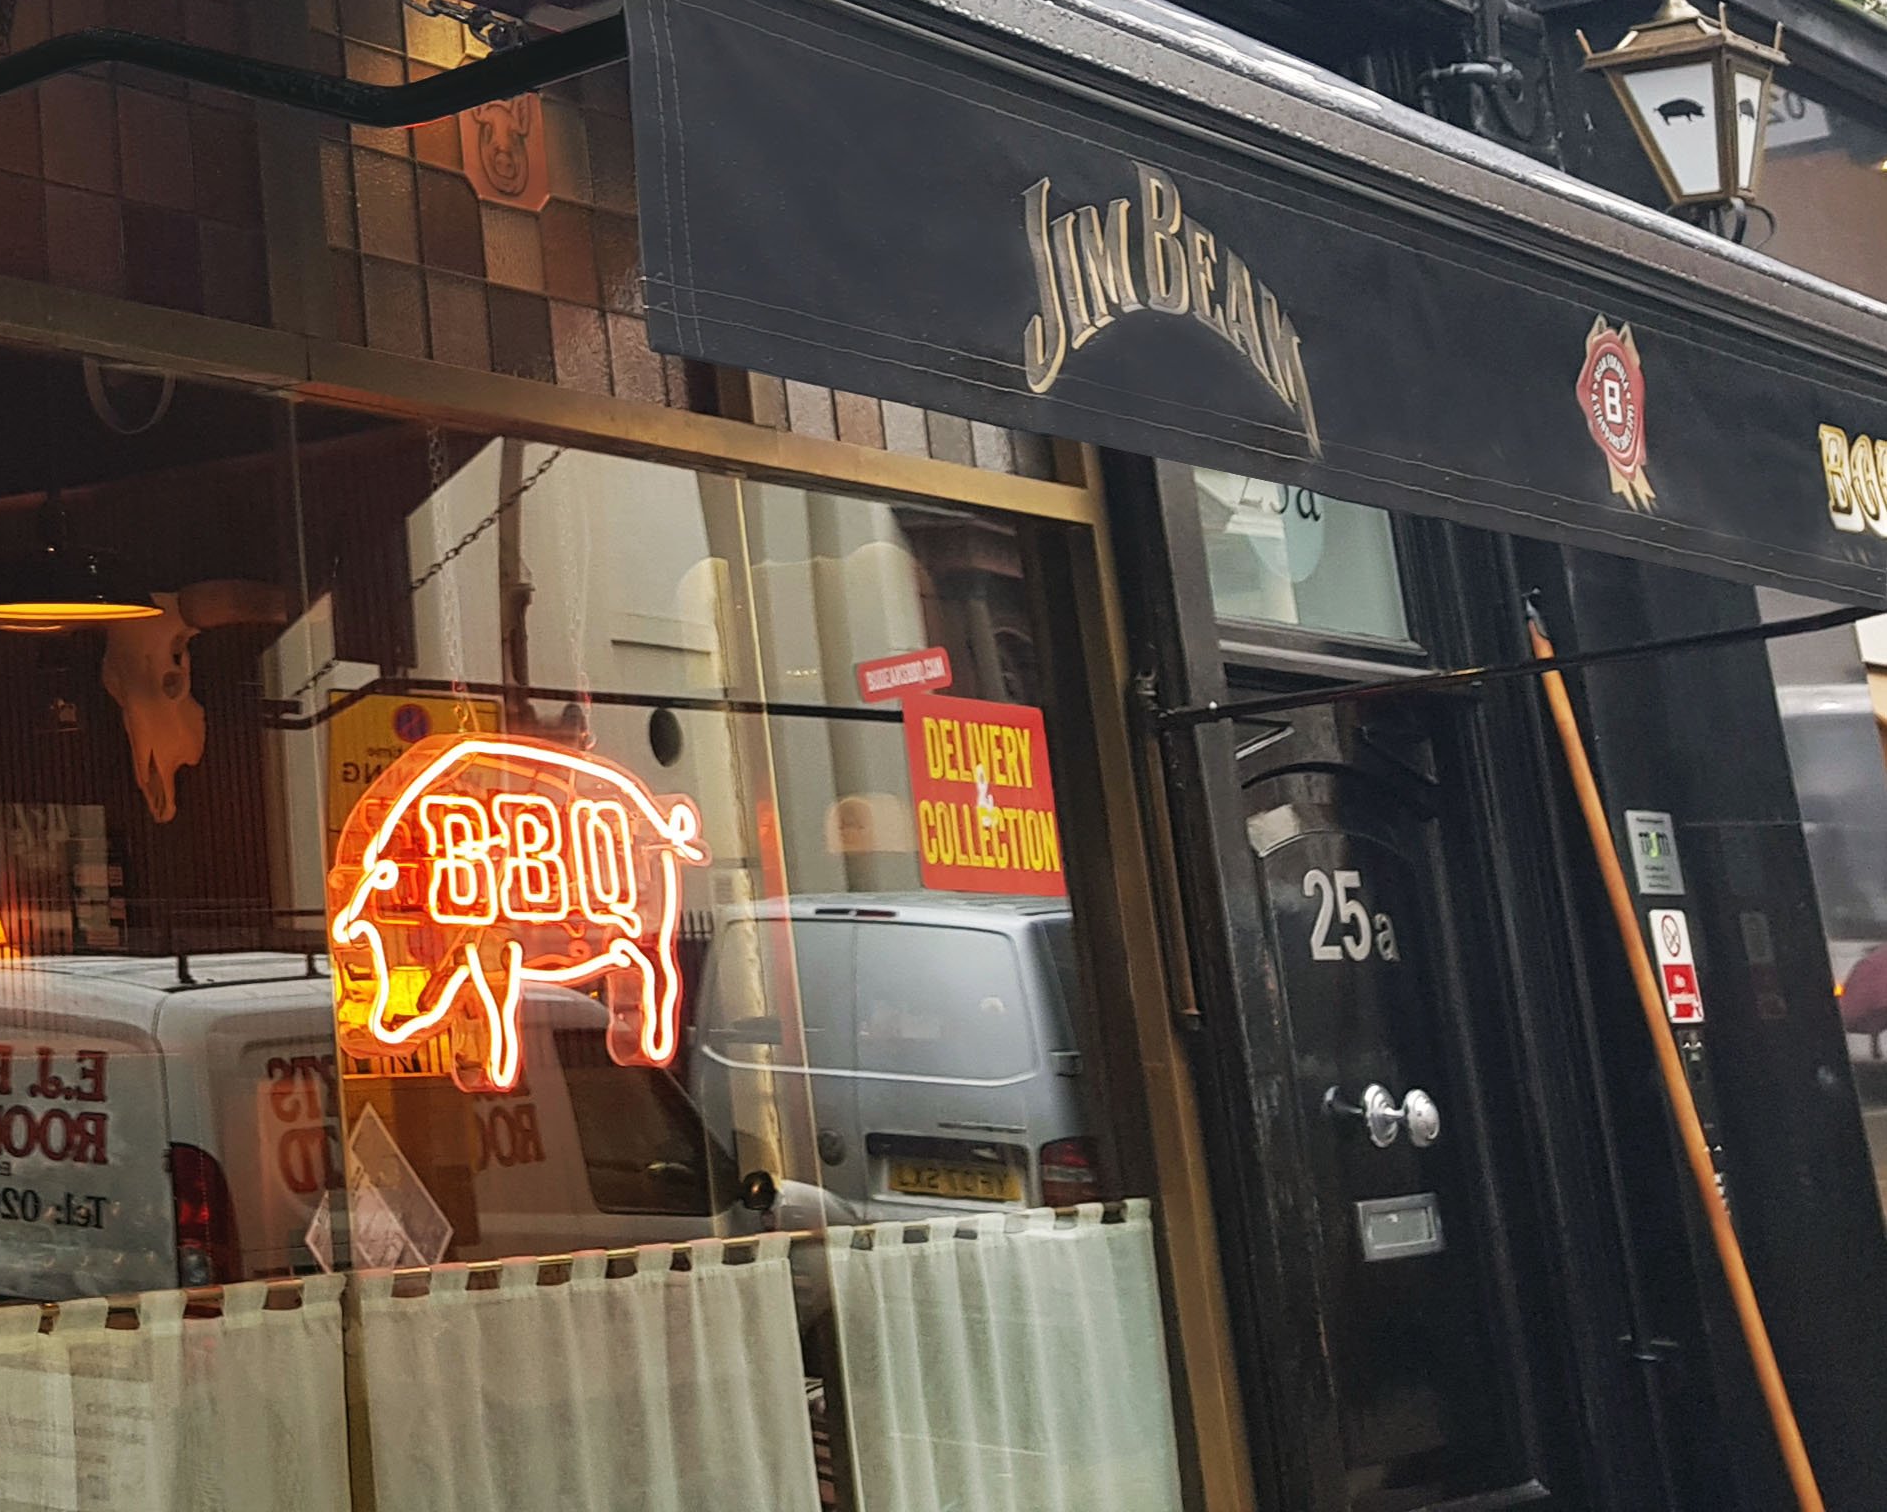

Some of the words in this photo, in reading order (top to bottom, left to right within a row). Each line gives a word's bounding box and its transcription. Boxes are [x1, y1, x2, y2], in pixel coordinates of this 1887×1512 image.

[1021, 176, 1145, 394] JIM
[1132, 159, 1323, 460] BEAM
[1603, 378, 1624, 425] B
[922, 716, 1033, 789] DELIVERY
[419, 793, 641, 938] BBQ
[918, 799, 1061, 873] COLLECTION
[1303, 869, 1401, 963] 25a
